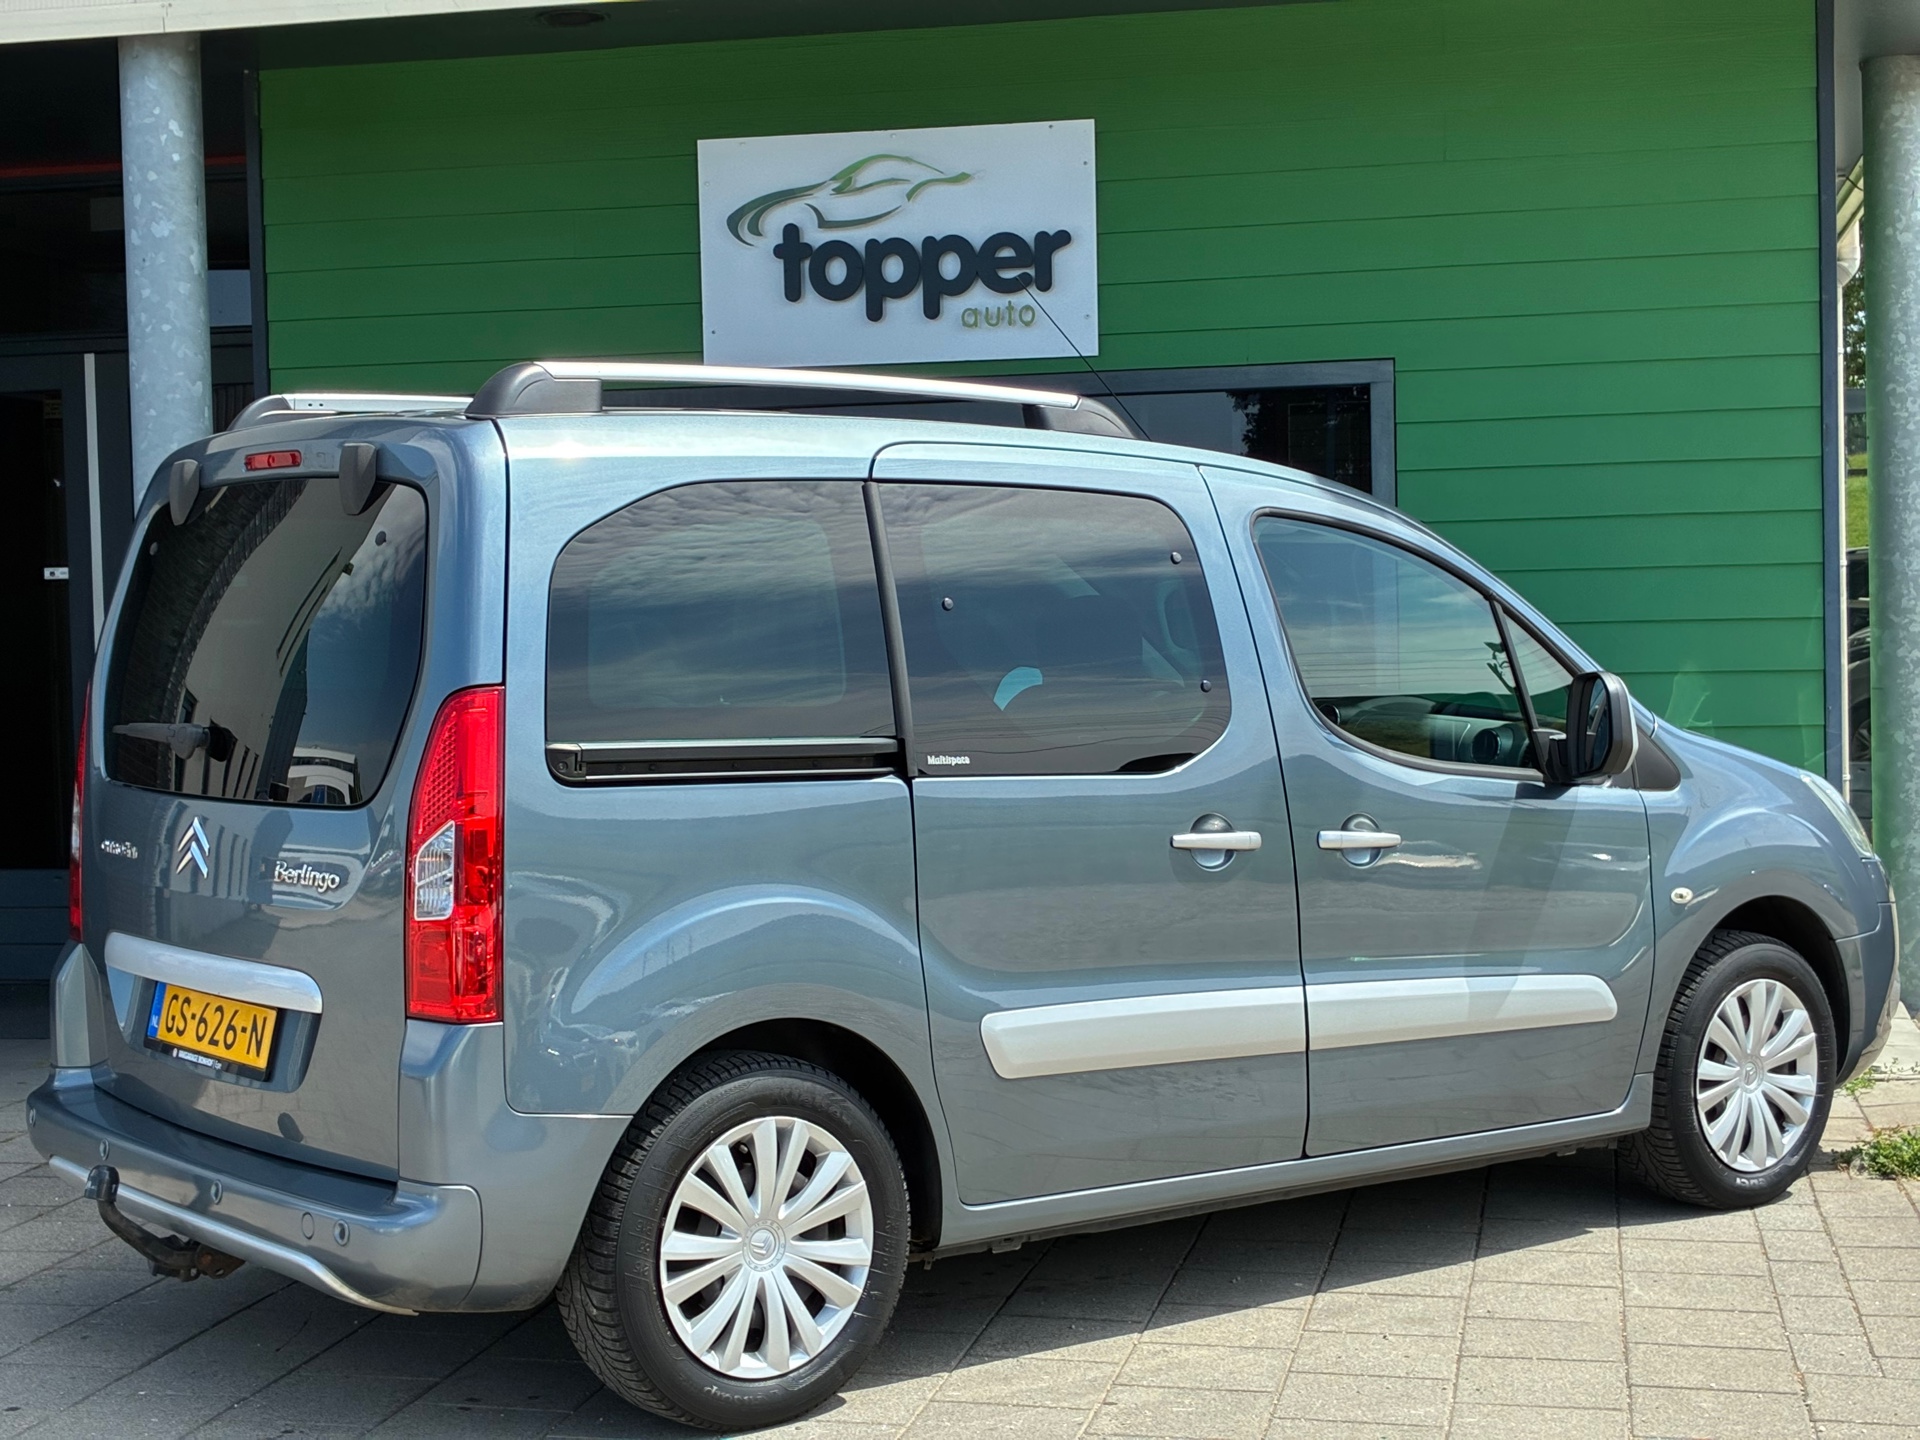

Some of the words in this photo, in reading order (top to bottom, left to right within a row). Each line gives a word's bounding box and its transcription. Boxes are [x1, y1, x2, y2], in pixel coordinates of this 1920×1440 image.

[773, 222, 1072, 322] topper
[961, 299, 1036, 328] auto
[274, 860, 341, 892] Berlingo
[165, 993, 268, 1058] GS-626-N
